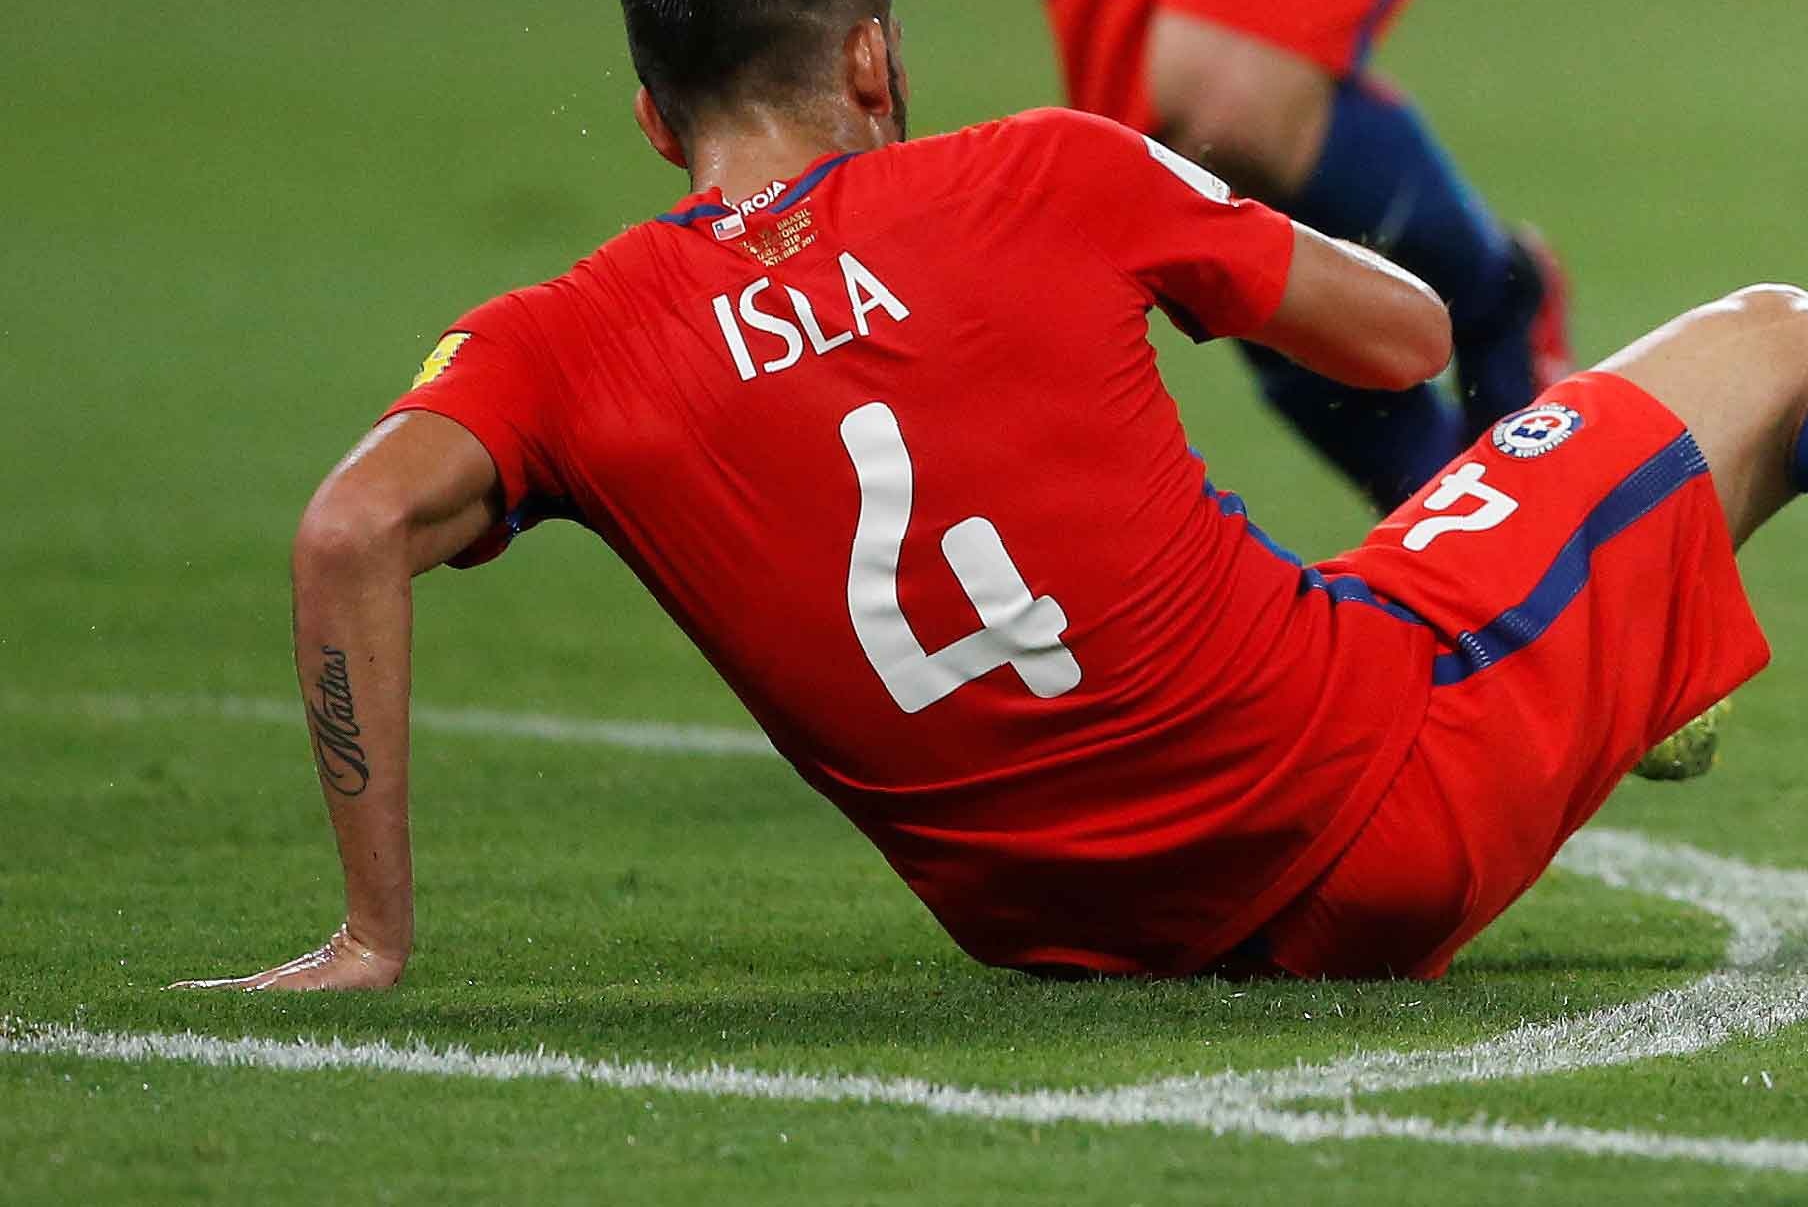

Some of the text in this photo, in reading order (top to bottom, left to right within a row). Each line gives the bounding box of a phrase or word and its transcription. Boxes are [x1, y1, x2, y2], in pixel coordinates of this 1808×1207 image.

[740, 180, 788, 216] ROJA
[712, 251, 910, 381] ISLA
[840, 401, 1082, 713] 4
[1402, 461, 1520, 552] 4
